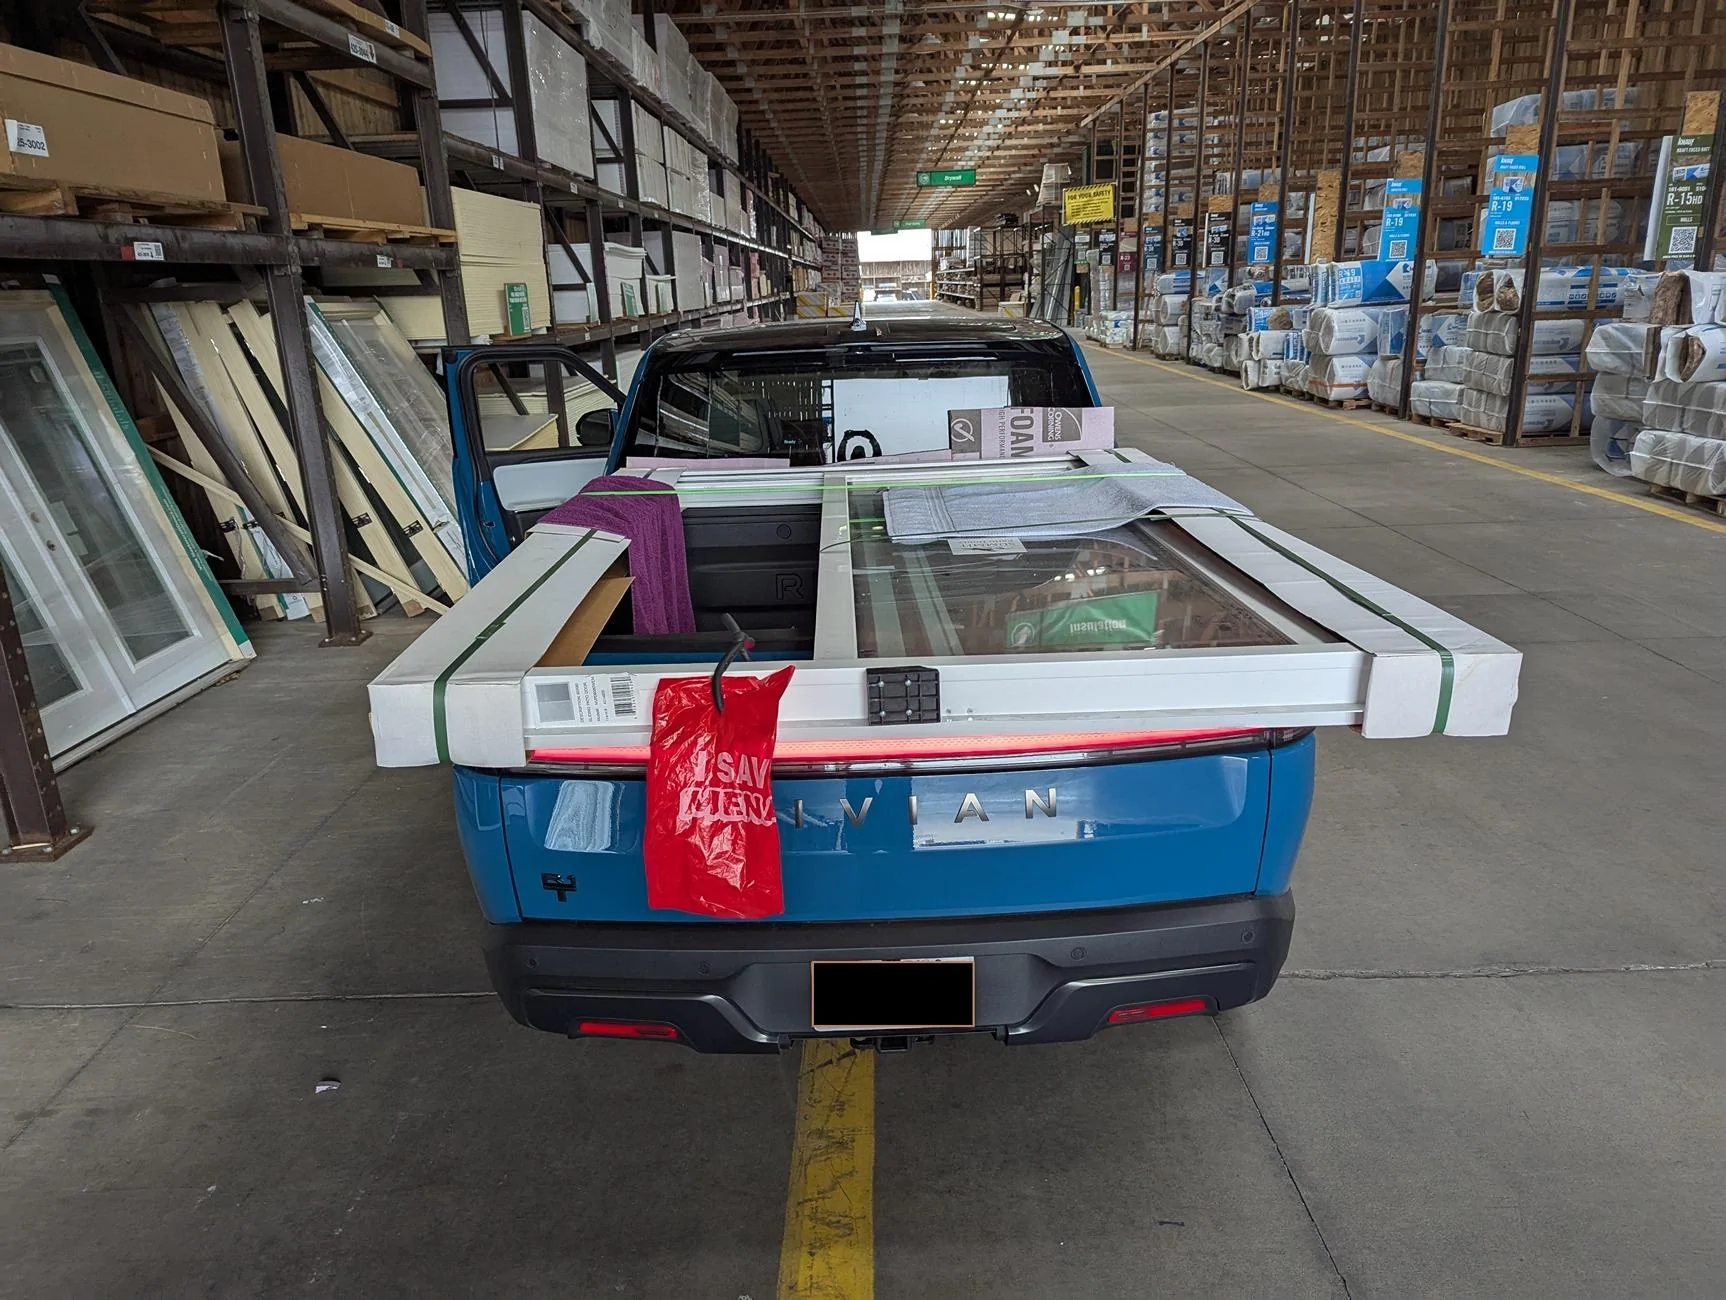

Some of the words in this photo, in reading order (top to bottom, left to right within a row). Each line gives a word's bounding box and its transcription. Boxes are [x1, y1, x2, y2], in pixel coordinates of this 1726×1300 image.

[1093, 190, 1111, 198] SAFETY
[1491, 201, 1513, 212] R-19
[1385, 218, 1403, 227] R-19
[1047, 408, 1055, 441] CORNING
[1054, 411, 1063, 441] OWENS
[716, 751, 770, 789] SAV
[795, 787, 1057, 829] IVIAN
